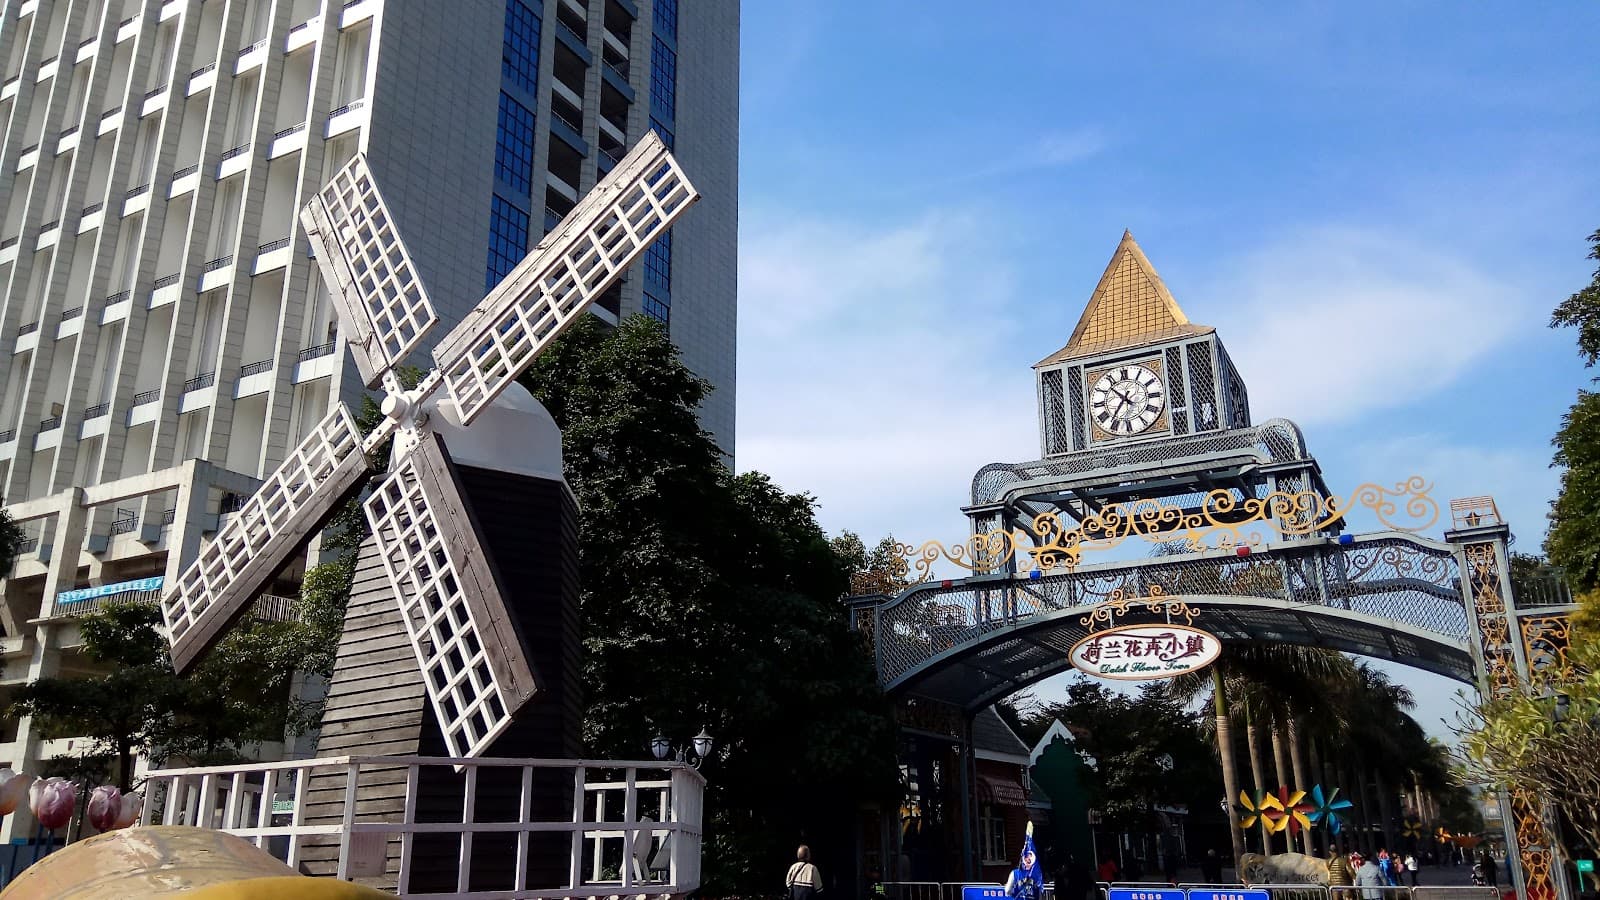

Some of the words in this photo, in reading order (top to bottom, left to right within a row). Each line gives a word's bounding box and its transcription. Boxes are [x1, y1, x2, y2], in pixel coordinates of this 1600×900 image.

[1081, 633, 1205, 664] 荷兰花卉小镇
[1100, 663, 1128, 674] Dutch
[1132, 662, 1161, 673] Flower
[1165, 659, 1190, 670] Town
